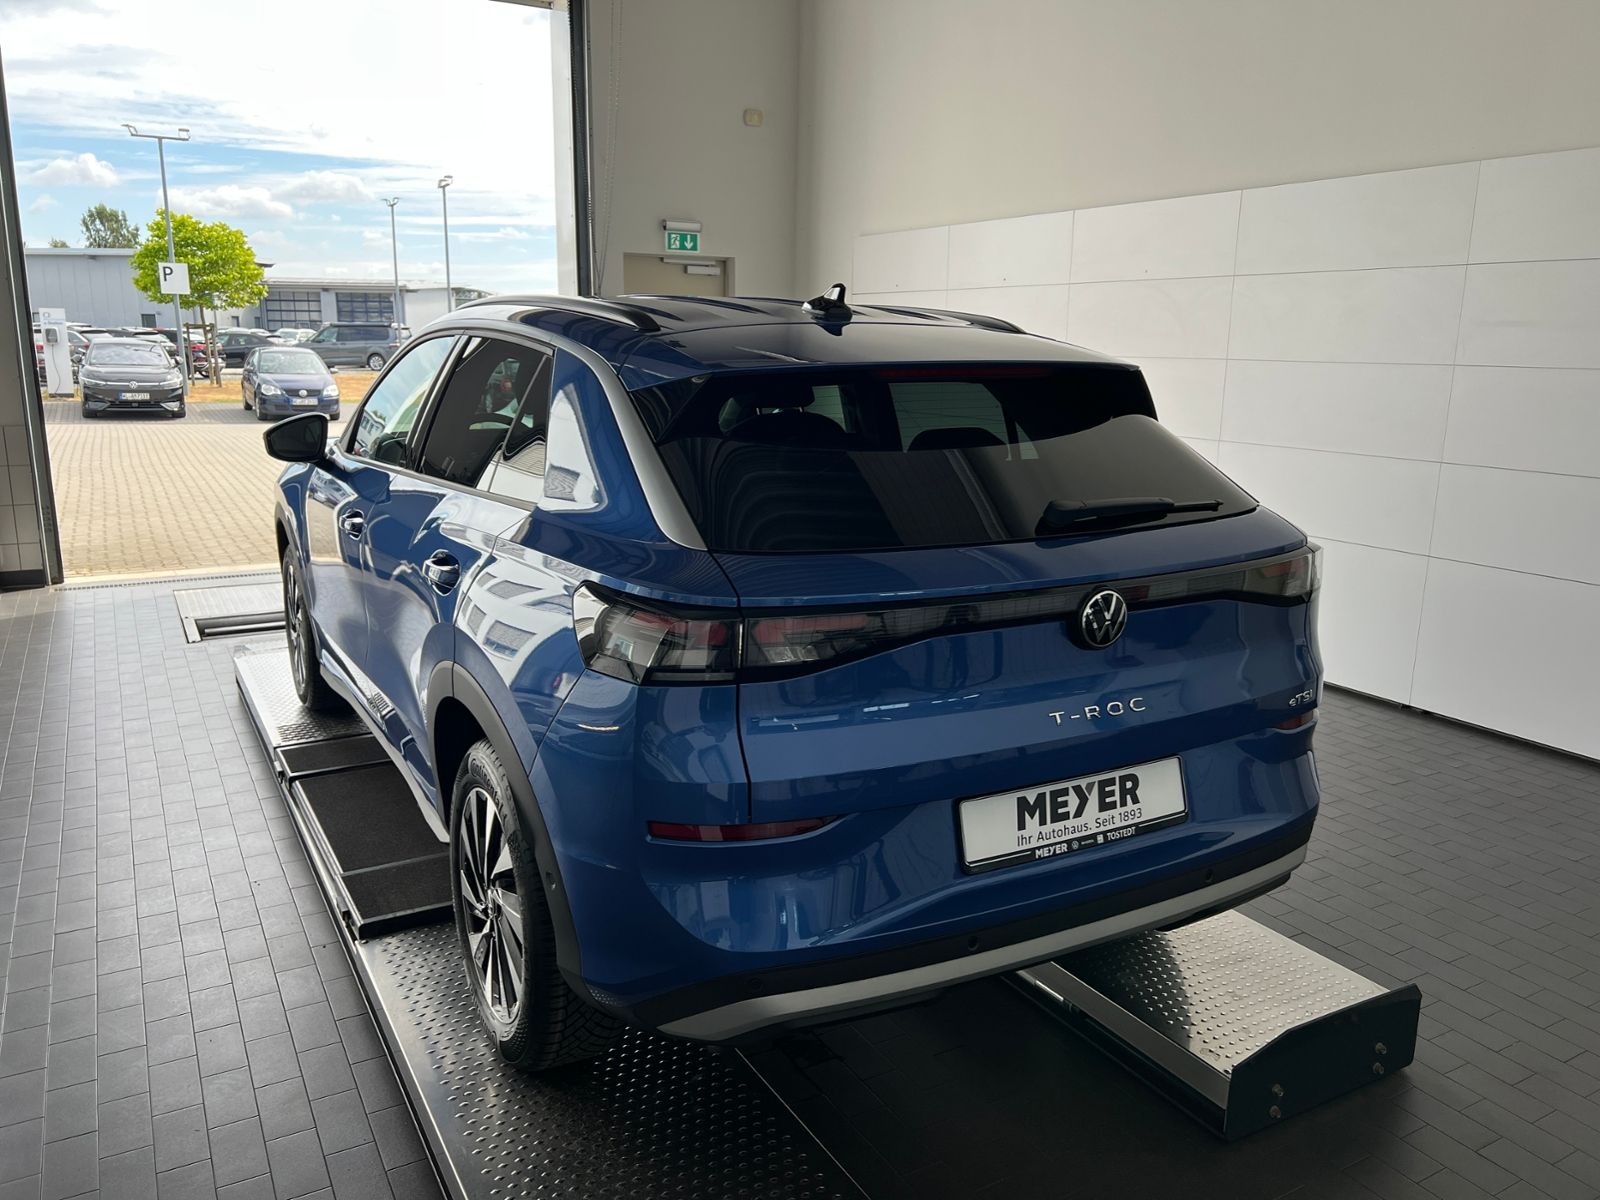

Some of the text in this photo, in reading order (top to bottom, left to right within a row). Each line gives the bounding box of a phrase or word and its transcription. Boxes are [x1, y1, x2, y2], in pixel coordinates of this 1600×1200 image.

[163, 266, 173, 281] P
[1049, 697, 1146, 725] T-ROC
[1289, 689, 1313, 706] eTSI
[1016, 773, 1141, 832] MEYER
[1017, 807, 1143, 847] Ihr Autohaus. Seit 1893
[1035, 842, 1068, 859] MEYER
[1107, 826, 1136, 841] TOSTEDT
